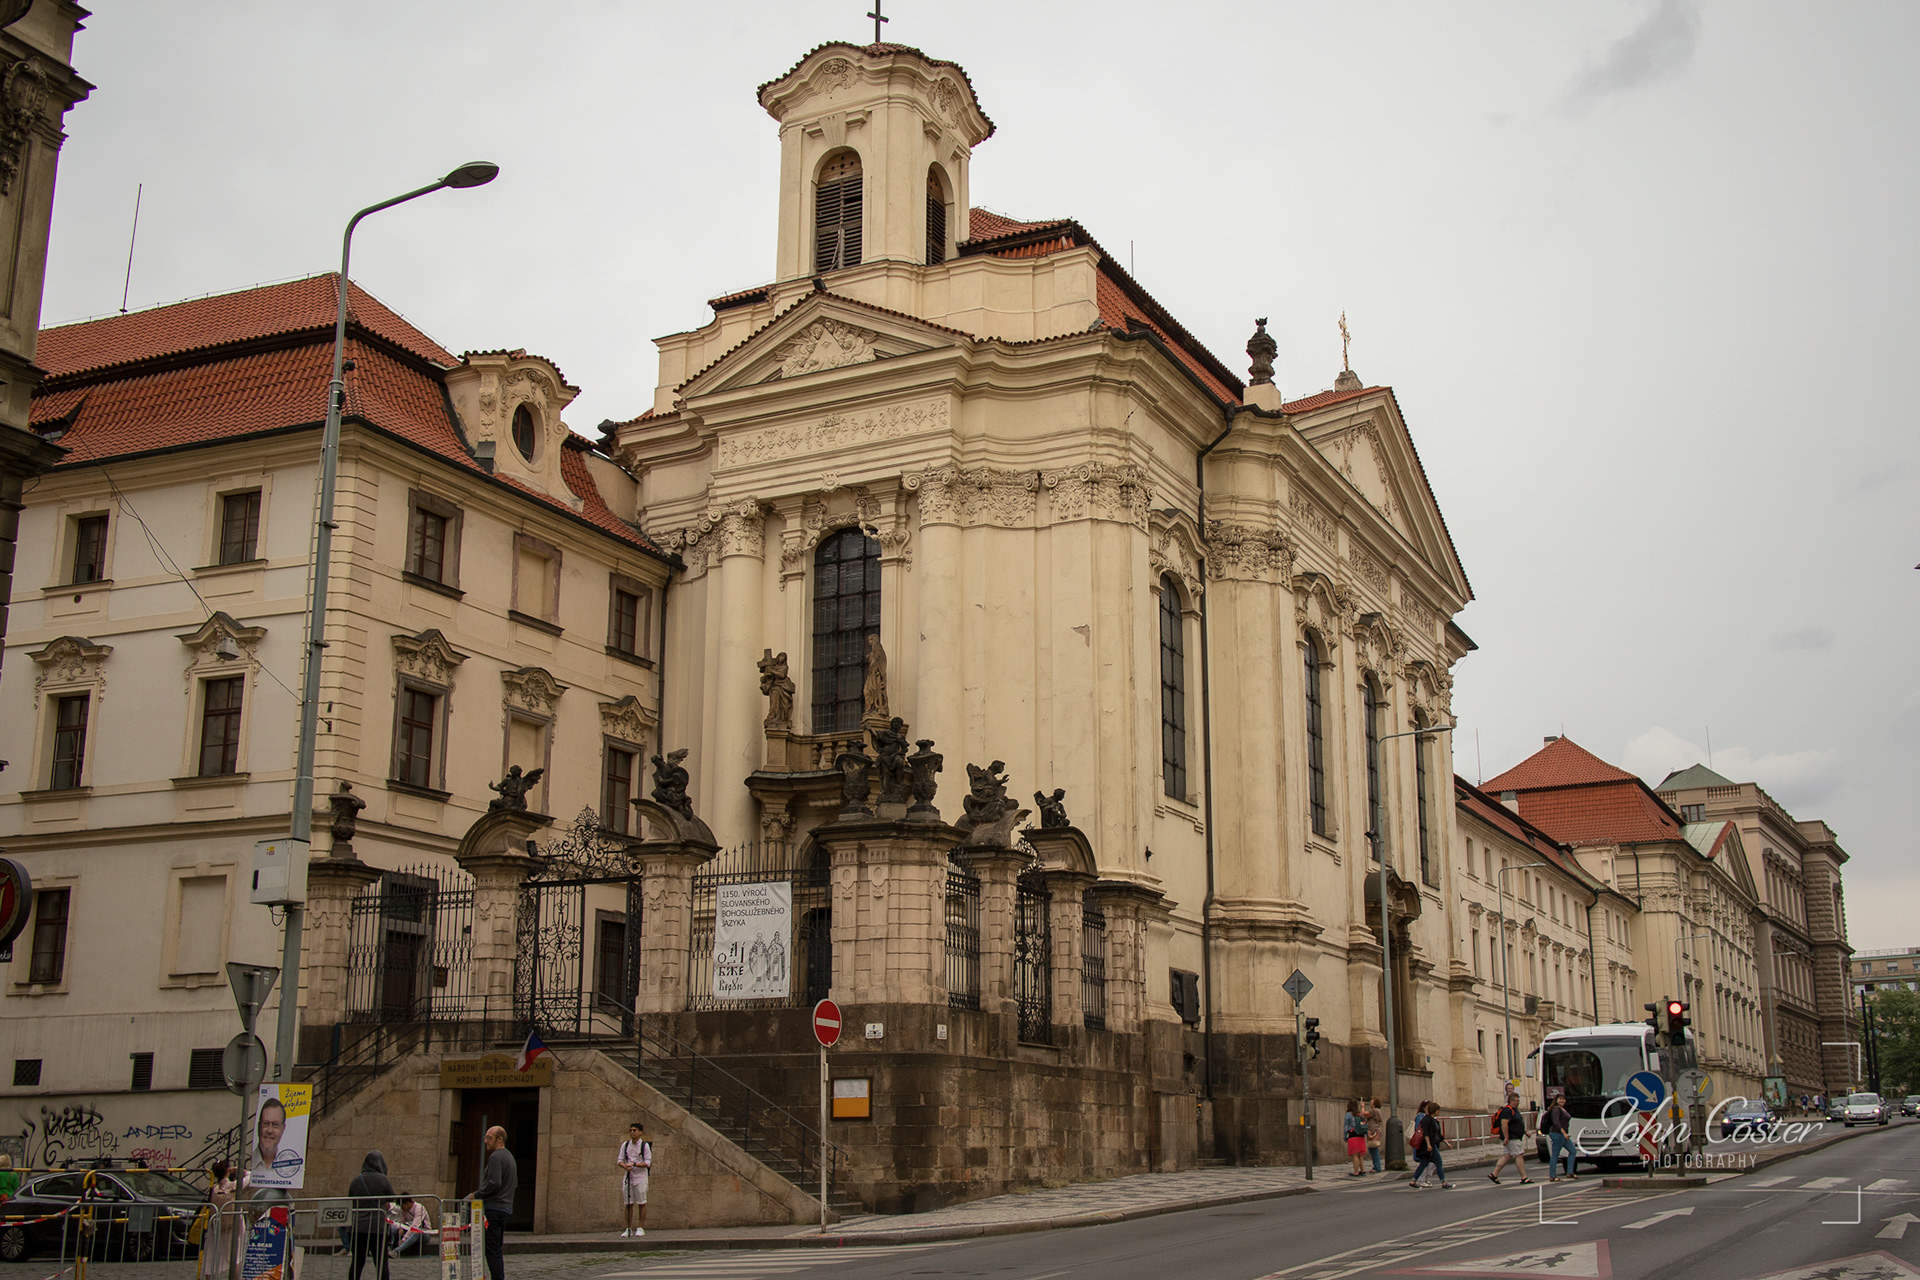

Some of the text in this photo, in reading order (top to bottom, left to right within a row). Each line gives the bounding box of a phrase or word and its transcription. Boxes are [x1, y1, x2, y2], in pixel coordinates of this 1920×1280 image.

[722, 887, 767, 898] 1150. VÝROČÍ
[721, 897, 770, 907] SLOVANSKÉHO
[721, 906, 785, 917] BOHOSLUŽEBNÉHO
[722, 919, 746, 927] JAZYKA
[447, 1063, 478, 1073] NÁRODNÍ
[456, 1073, 535, 1085] HRDINŮ HEYDRICHIADY
[325, 1210, 346, 1220] SEG
